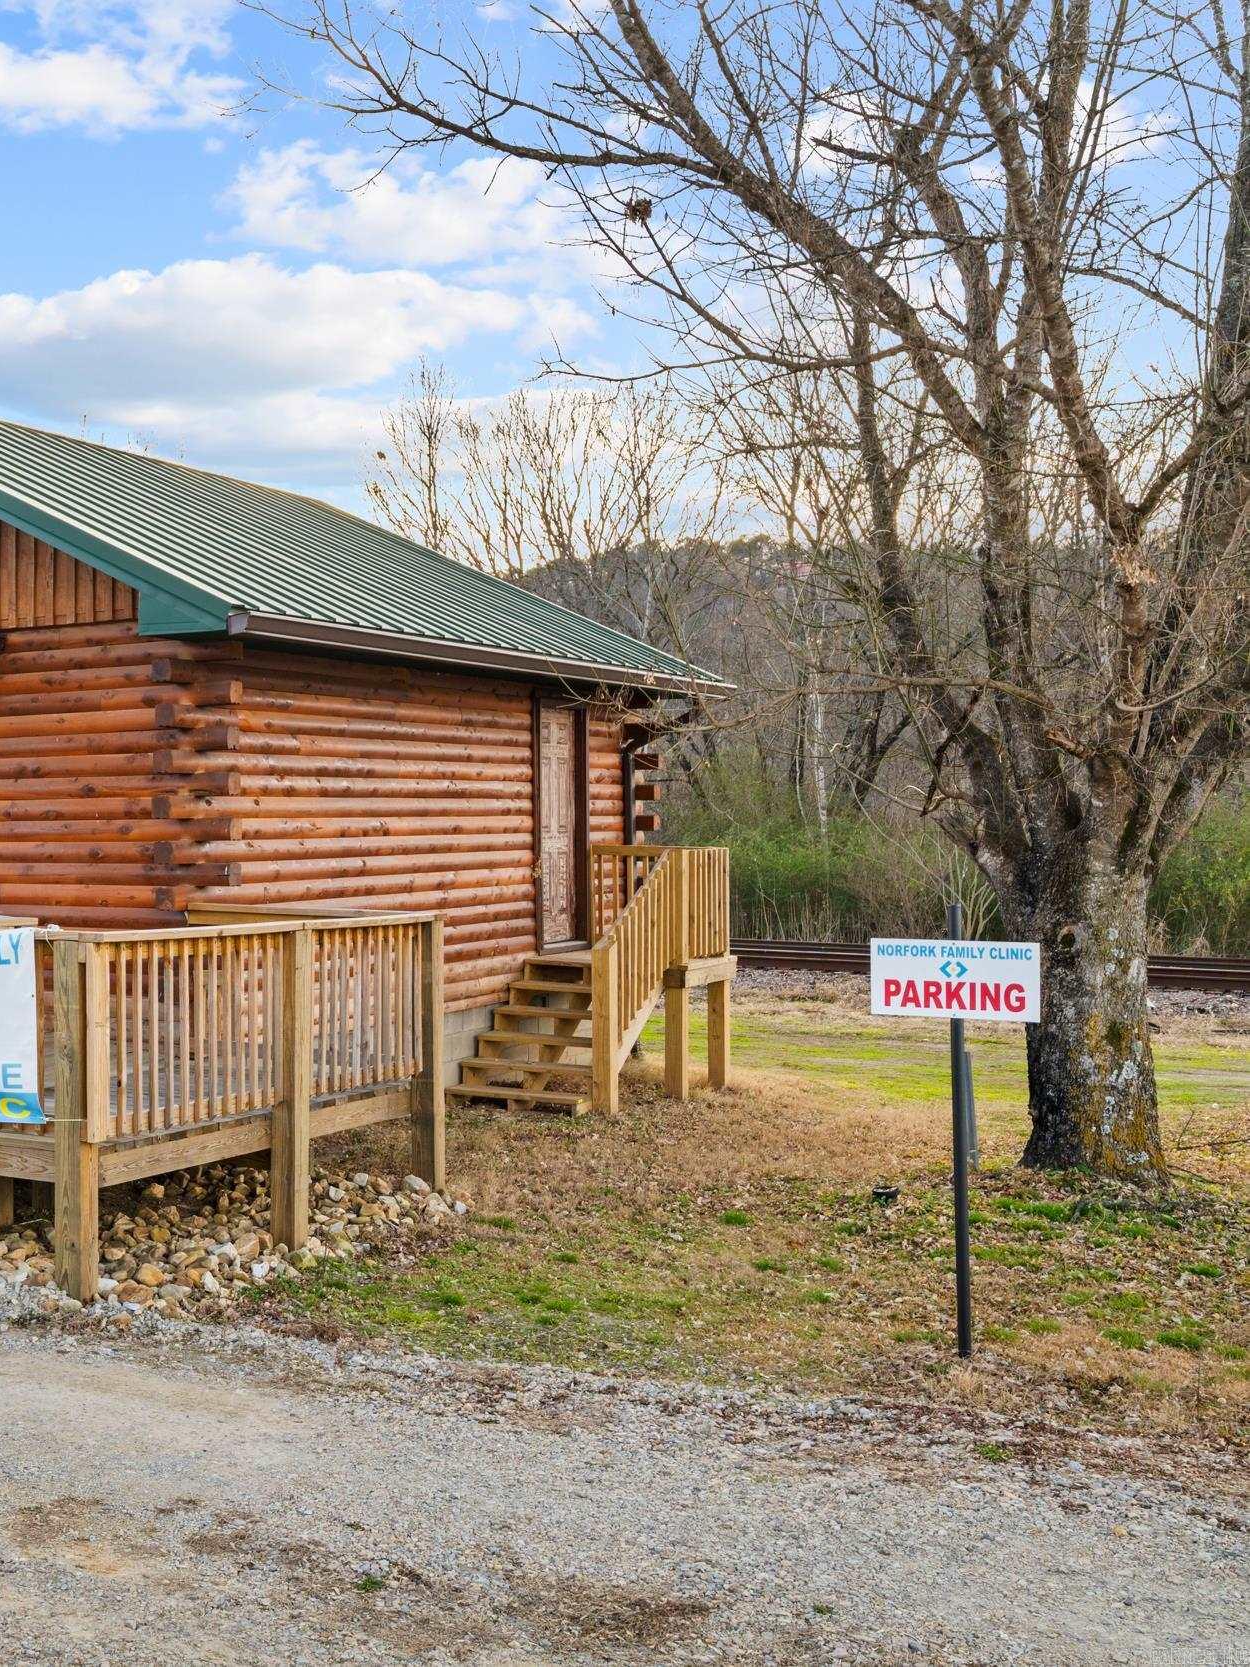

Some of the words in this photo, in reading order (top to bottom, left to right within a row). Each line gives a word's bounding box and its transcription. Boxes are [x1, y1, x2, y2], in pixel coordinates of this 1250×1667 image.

[877, 944, 936, 957] NORFORK
[941, 946, 985, 959] FAMILY
[990, 947, 1033, 961] CLINIC
[884, 979, 1026, 1013] PARKING
